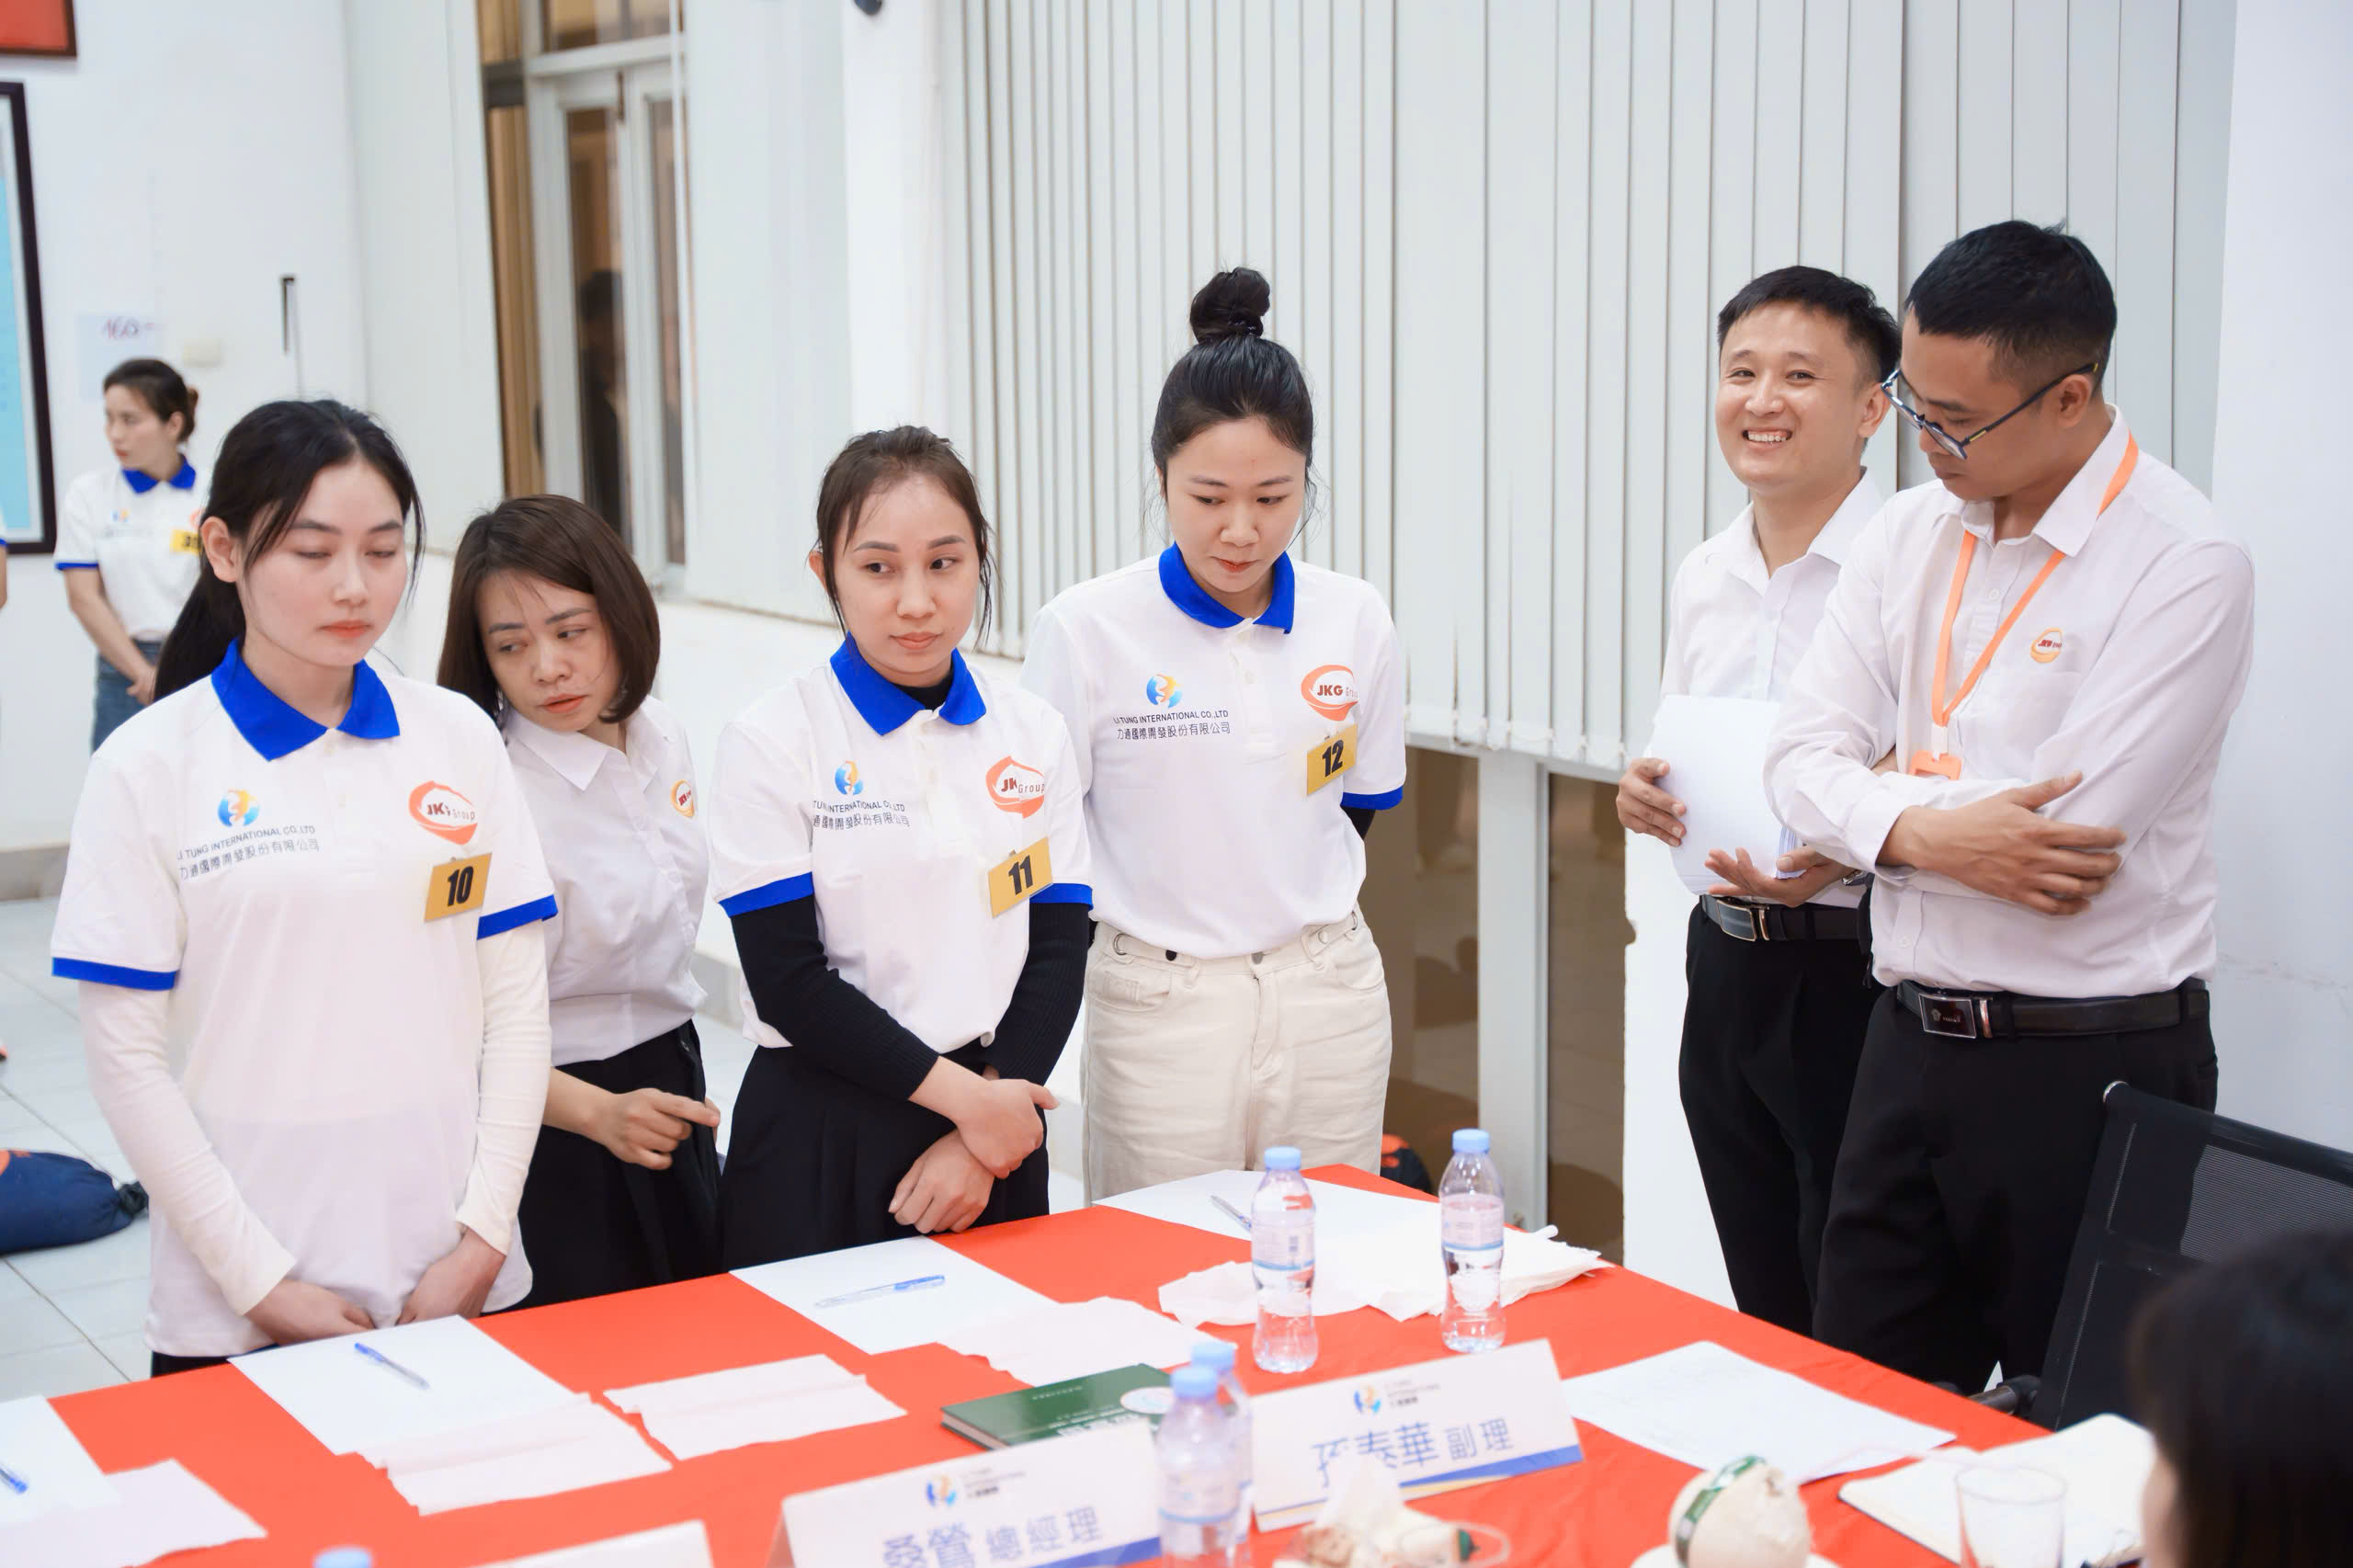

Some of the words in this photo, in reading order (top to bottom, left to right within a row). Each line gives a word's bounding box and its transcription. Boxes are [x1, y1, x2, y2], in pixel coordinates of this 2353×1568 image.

[1316, 685, 1343, 696] JKG
[1120, 716, 1139, 724] TUNG
[1139, 711, 1199, 724] INTERNATIONAL
[1117, 722, 1231, 740] 力通國際開發股份有限公司
[1322, 739, 1344, 778] 12
[1001, 778, 1017, 792] JK
[827, 801, 882, 813] INTERNATIONAL
[186, 843, 209, 859] TUNG
[211, 827, 280, 850] INTERNATIONAL
[447, 866, 474, 907] 10
[1008, 855, 1033, 895] 11
[1444, 1418, 1515, 1461] 副理
